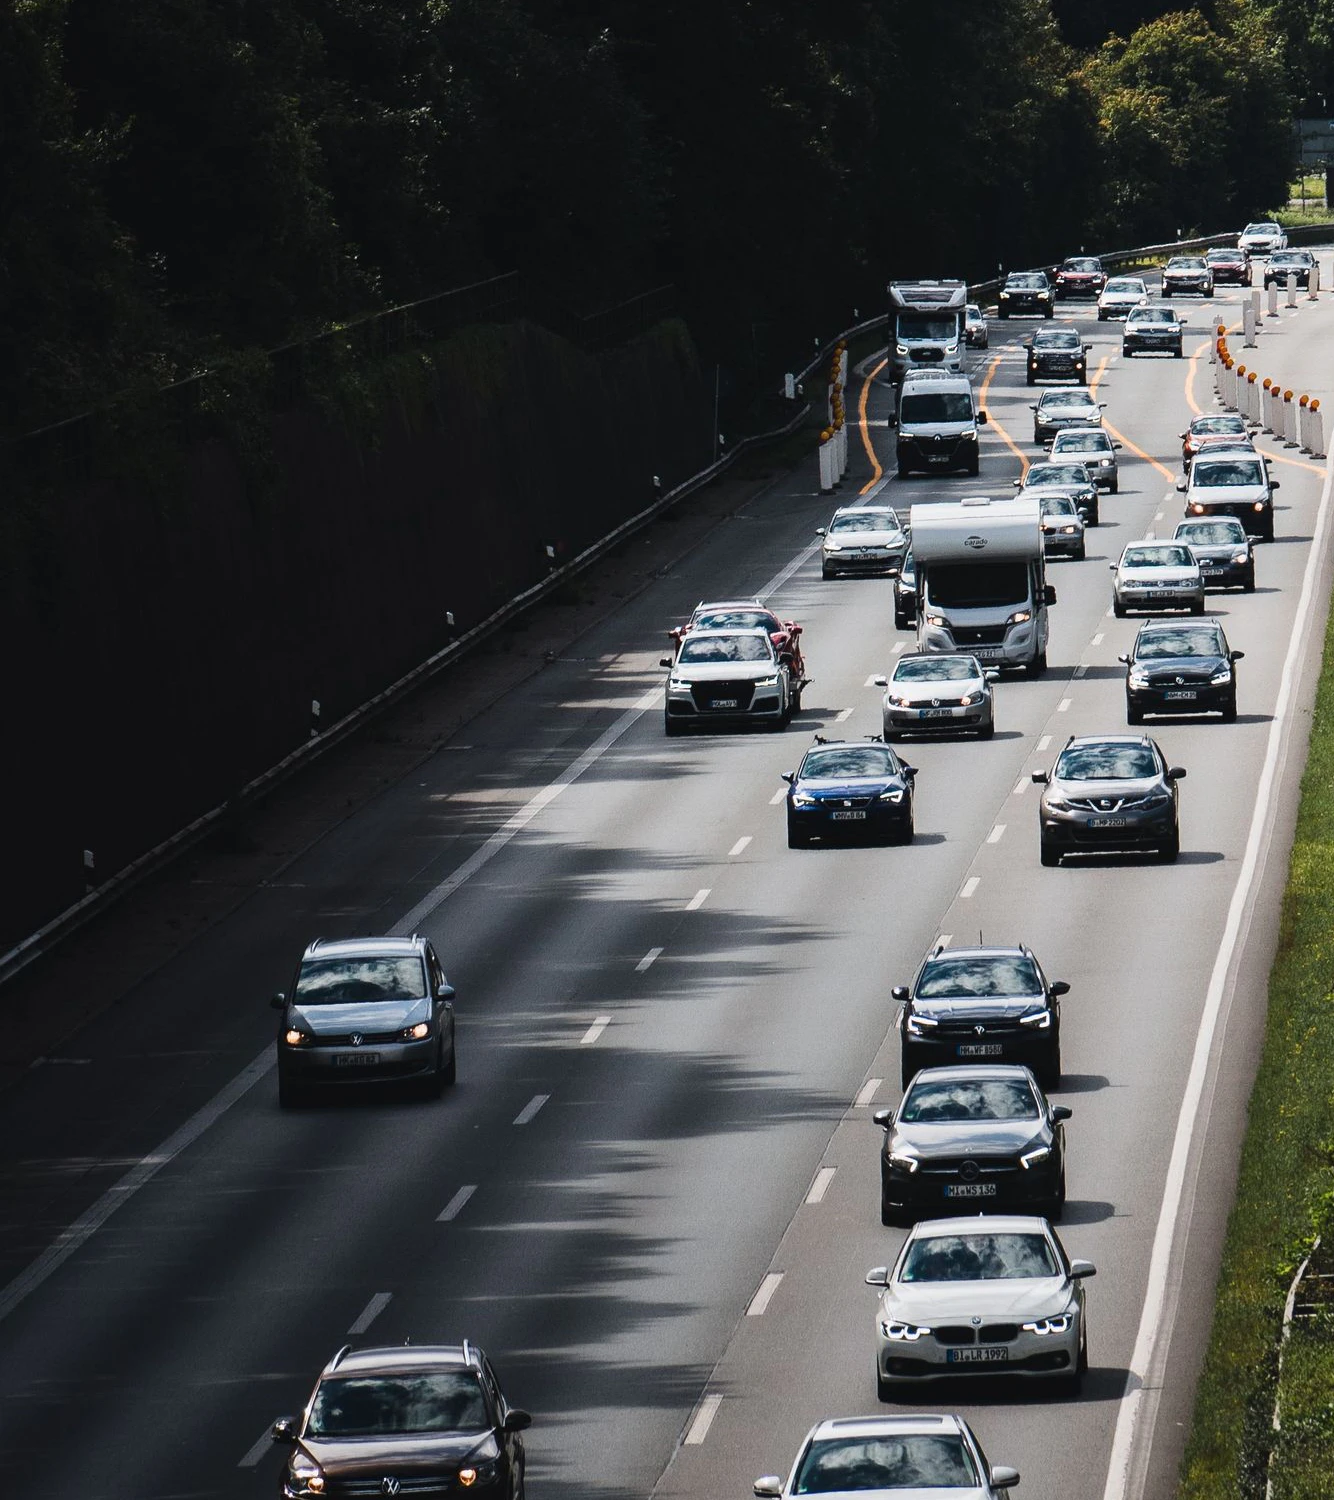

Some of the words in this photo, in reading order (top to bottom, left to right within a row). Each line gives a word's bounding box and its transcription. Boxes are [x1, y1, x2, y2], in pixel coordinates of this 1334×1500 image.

[964, 538, 988, 546] carado
[979, 1185, 995, 1195] 136
[953, 1350, 964, 1361] BI
[971, 1350, 982, 1360] LR
[984, 1348, 1006, 1360] 1992
